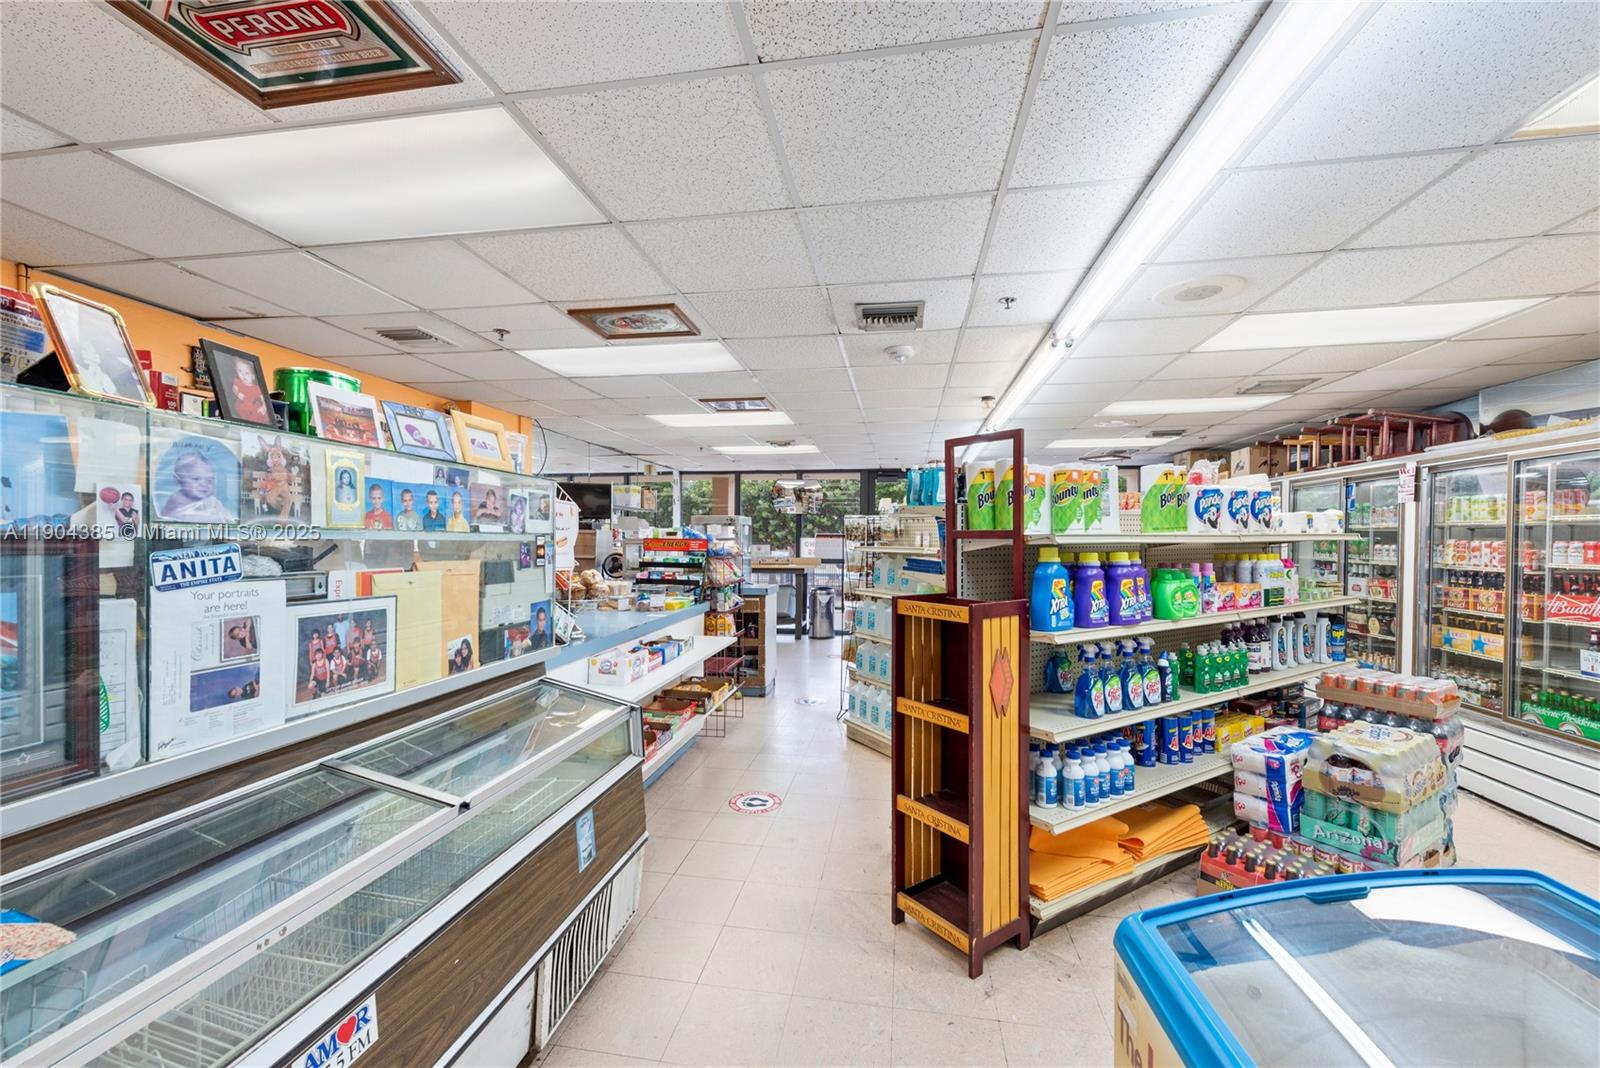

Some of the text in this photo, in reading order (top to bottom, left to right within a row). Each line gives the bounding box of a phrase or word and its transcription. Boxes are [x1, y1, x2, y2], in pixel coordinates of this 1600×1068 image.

[208, 5, 336, 40] PERONI
[161, 555, 237, 583] ANITA
[190, 588, 259, 601] Your portraits
[204, 600, 248, 614] are here!
[904, 604, 962, 619] SANTA CRISTINA
[904, 703, 962, 729] SANTA CRISTINA
[904, 802, 962, 838] SANTA CRISTINA
[904, 902, 962, 946] SANTA CRISTINA
[349, 1029, 371, 1060] FM
